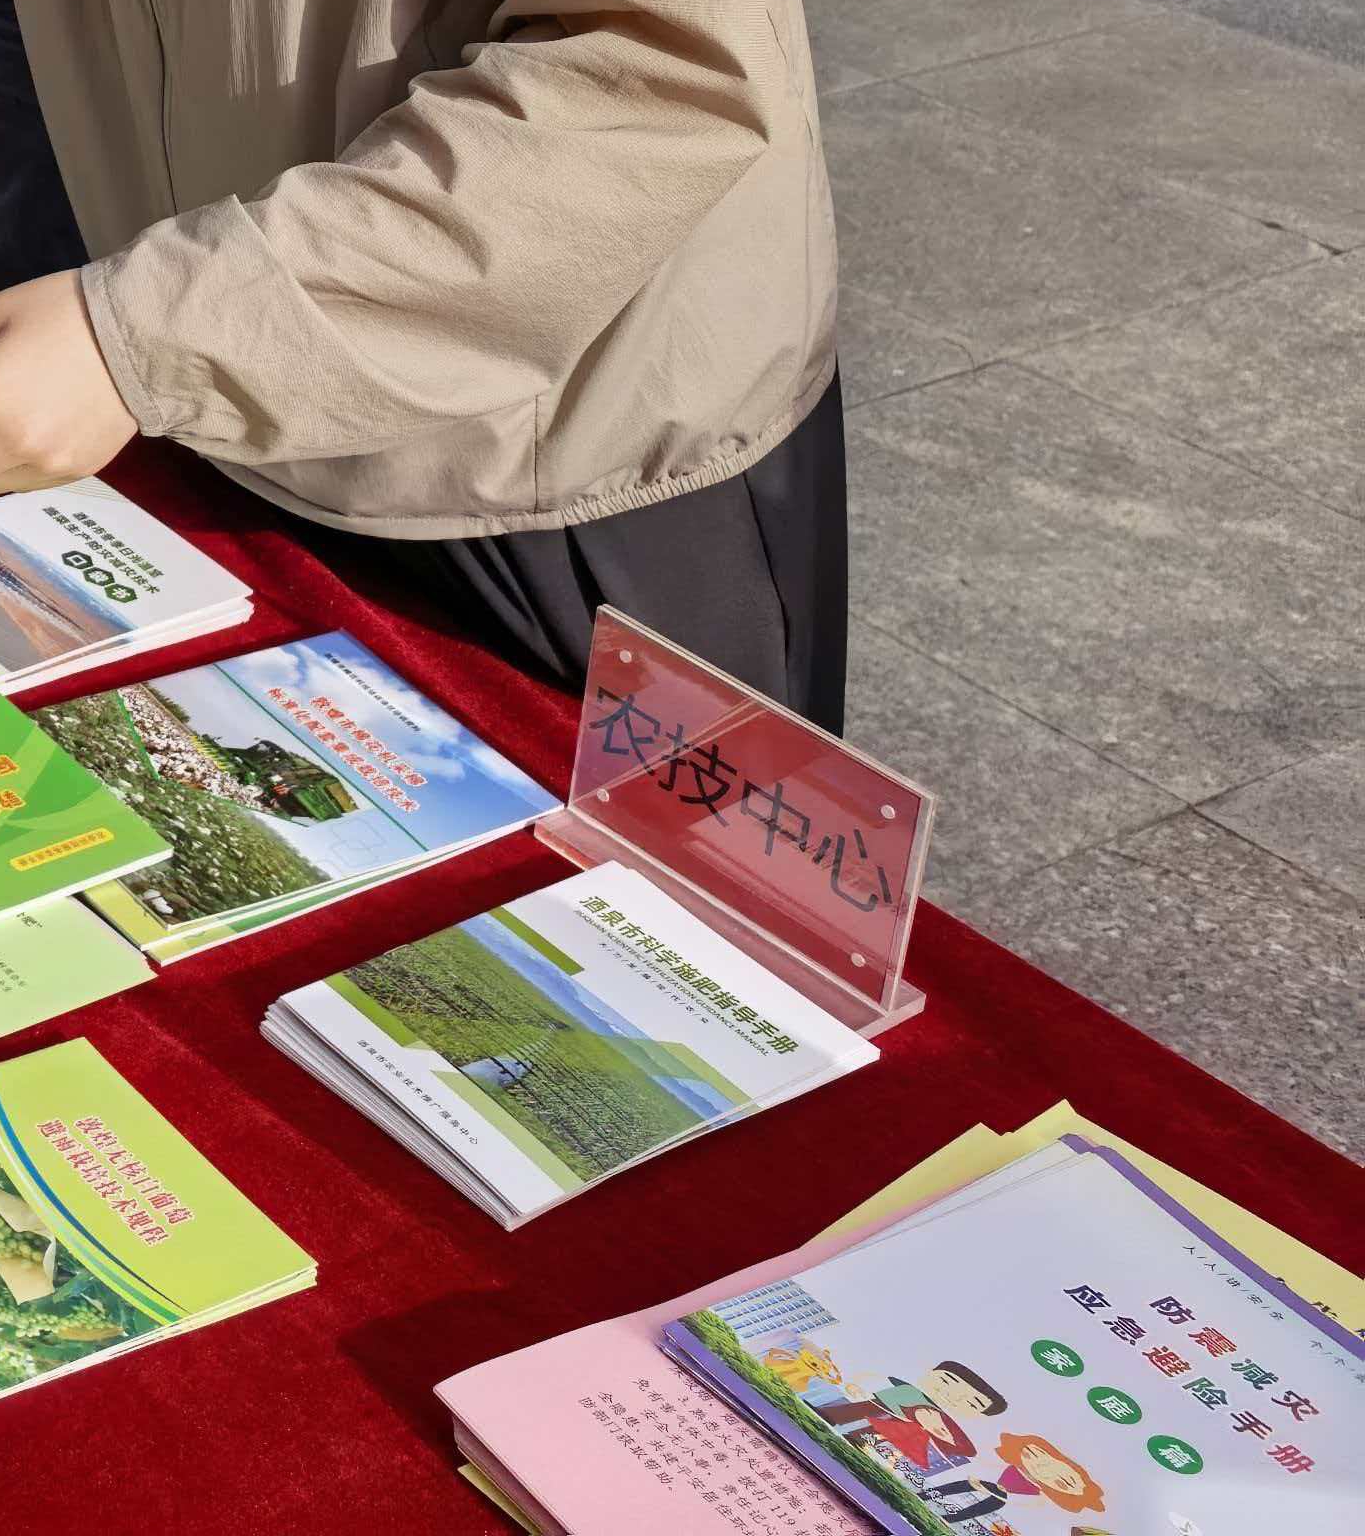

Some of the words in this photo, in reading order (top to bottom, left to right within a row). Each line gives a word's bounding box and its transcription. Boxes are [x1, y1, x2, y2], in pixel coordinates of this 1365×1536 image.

[42, 506, 161, 594] 蔬菜生产防灾减灾技术
[589, 686, 893, 912] 农技中心
[579, 895, 800, 1055] 酒泉市科学施肥指导手册
[692, 998, 736, 1029] GUIDANCE
[731, 1028, 773, 1056] MANUAL
[37, 1119, 169, 1246] 避雨栽培技术规程
[74, 1116, 194, 1225] 敦煌无核白葡萄
[1063, 1284, 1316, 1474] 应急避险手册
[1149, 1296, 1320, 1422] 防震减灾
